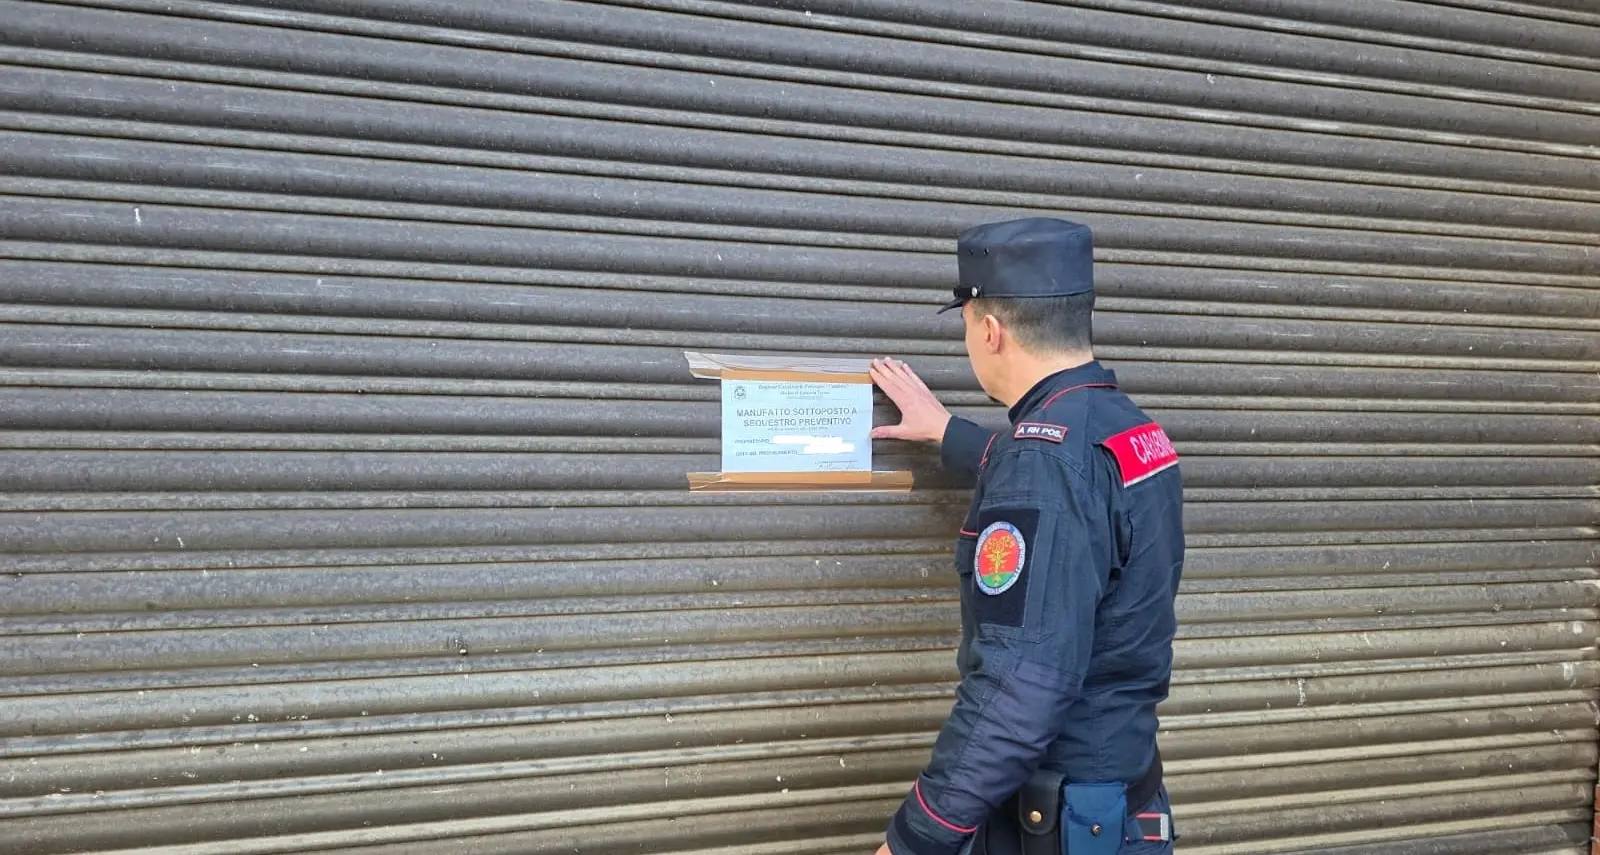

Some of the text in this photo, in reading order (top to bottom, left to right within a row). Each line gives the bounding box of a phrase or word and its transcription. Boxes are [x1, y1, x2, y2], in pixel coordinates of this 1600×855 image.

[736, 407, 858, 417] MANUFATTO SOTTOPOSTO A
[743, 417, 852, 428] SEQUESTRO PREVENTIVO
[1018, 426, 1062, 439] A RH POS.
